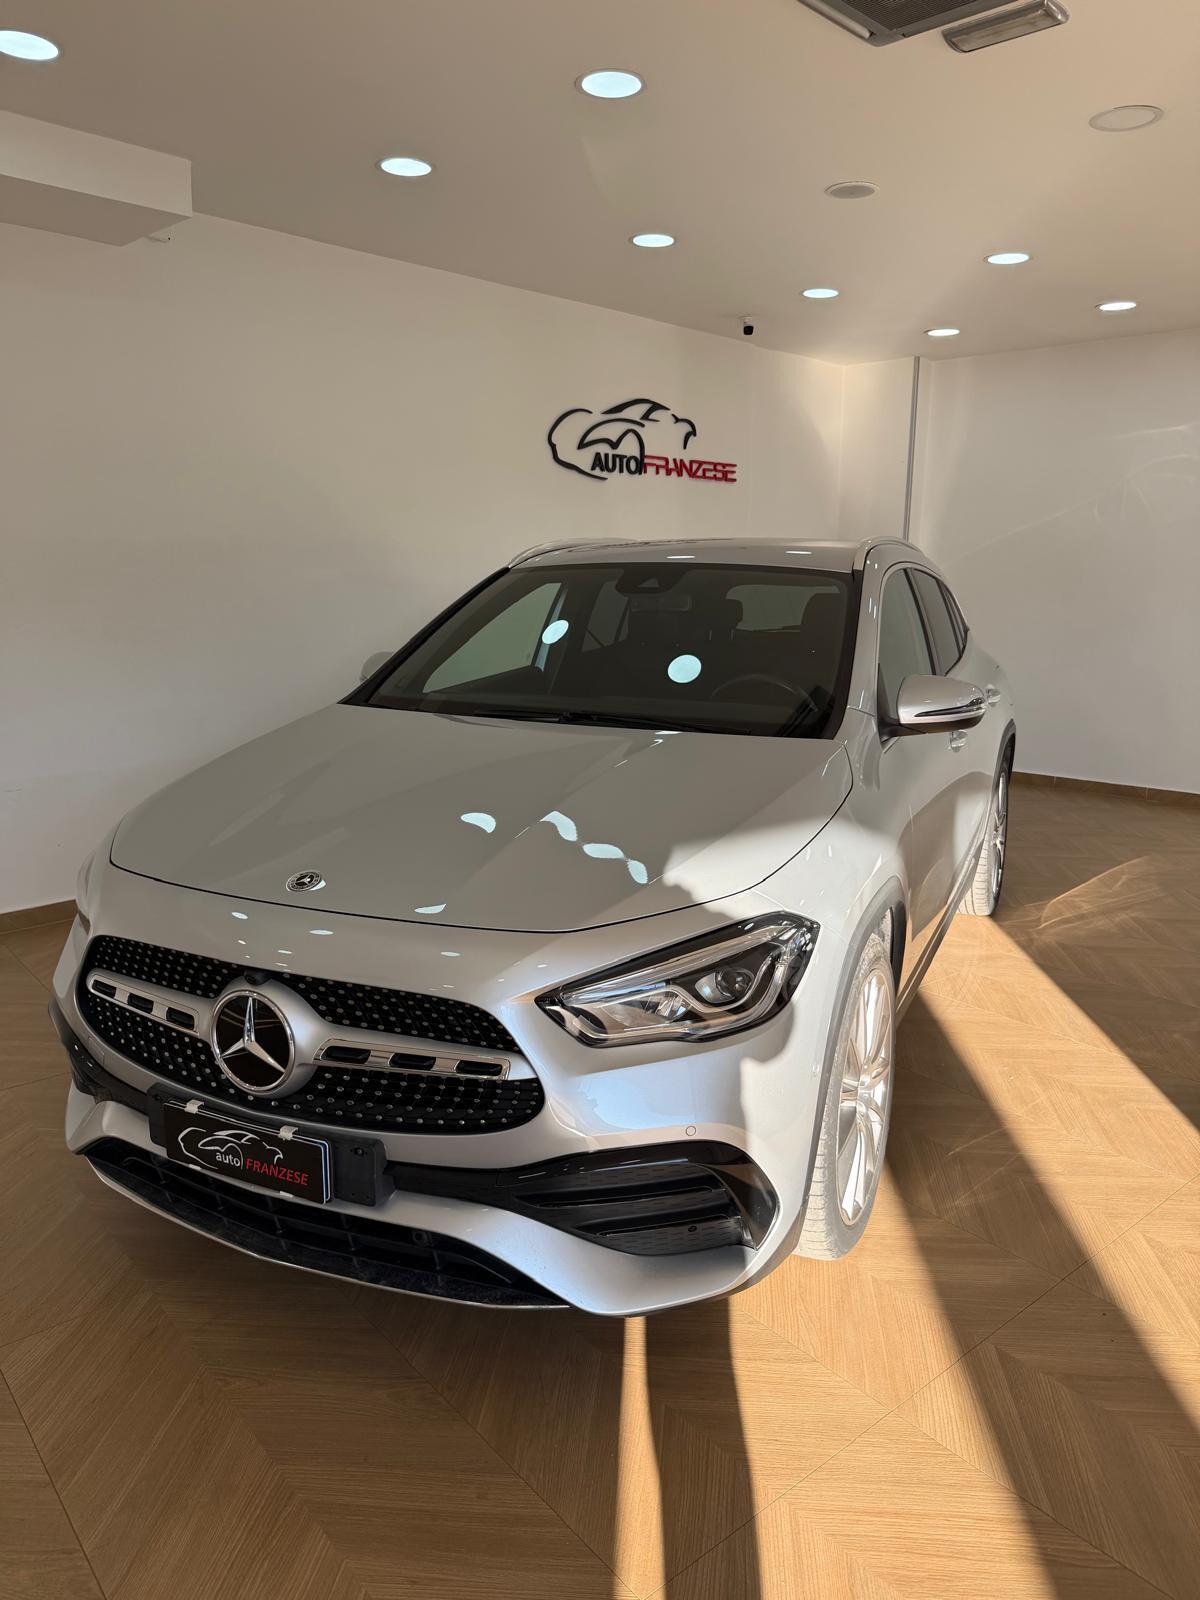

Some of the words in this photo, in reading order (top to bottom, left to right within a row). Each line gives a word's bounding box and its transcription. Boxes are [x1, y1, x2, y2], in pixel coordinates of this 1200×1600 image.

[591, 452, 640, 474] AUTO
[643, 455, 737, 482] FRANZESE
[215, 1152, 241, 1167] auto
[245, 1158, 309, 1186] FRANZESE
